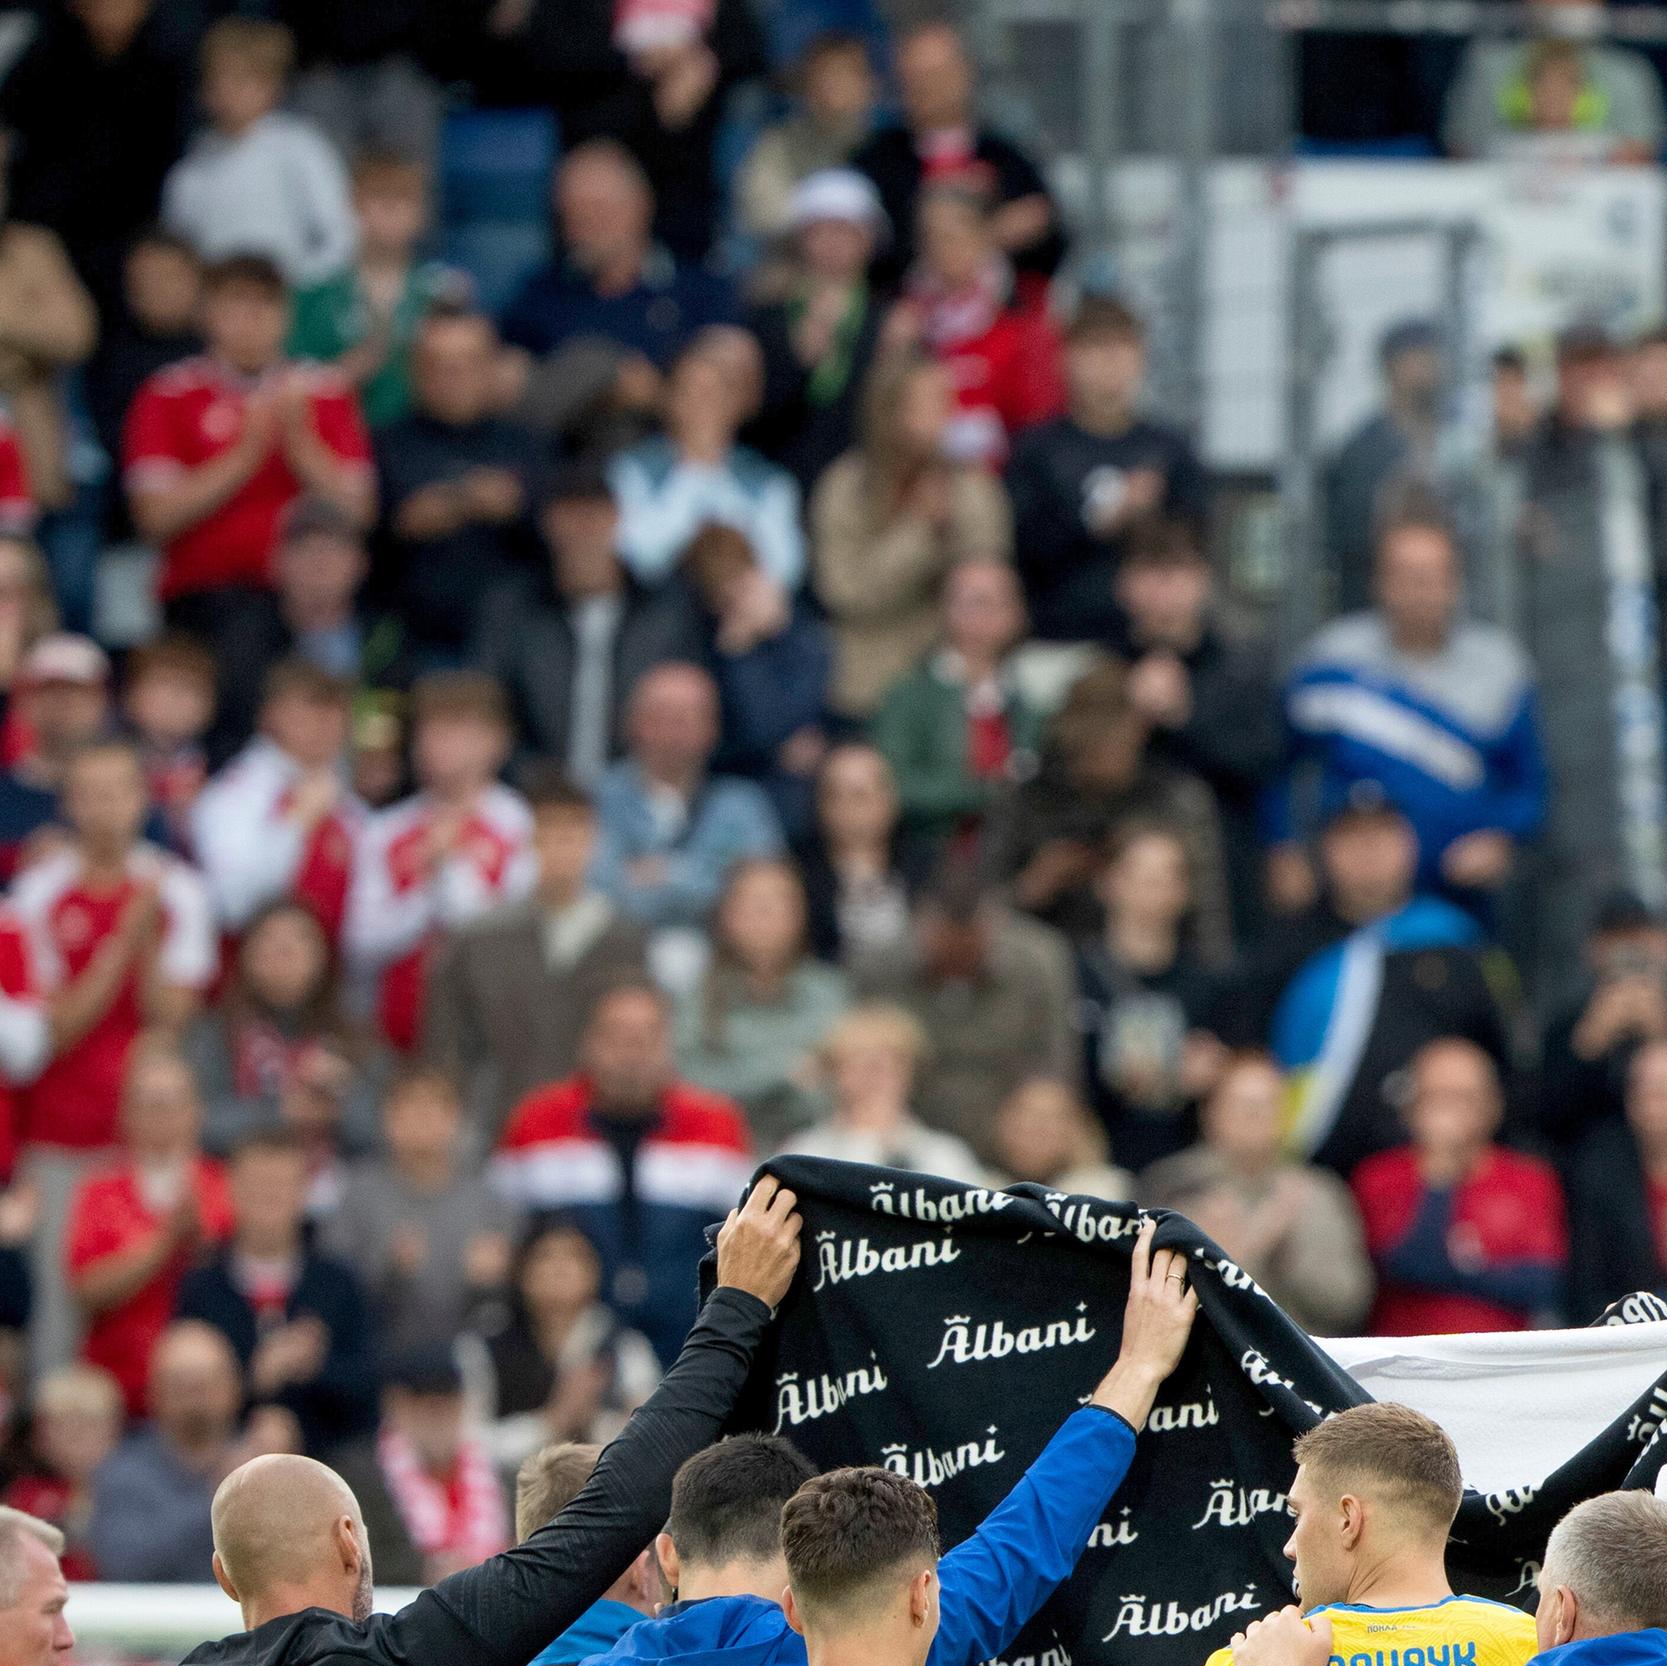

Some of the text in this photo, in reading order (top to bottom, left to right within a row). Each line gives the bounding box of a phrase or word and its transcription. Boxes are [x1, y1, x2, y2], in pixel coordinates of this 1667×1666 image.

[813, 1226, 961, 1291] Albani
[927, 1302, 1095, 1369] Albani
[1102, 1582, 1262, 1643] Albani
